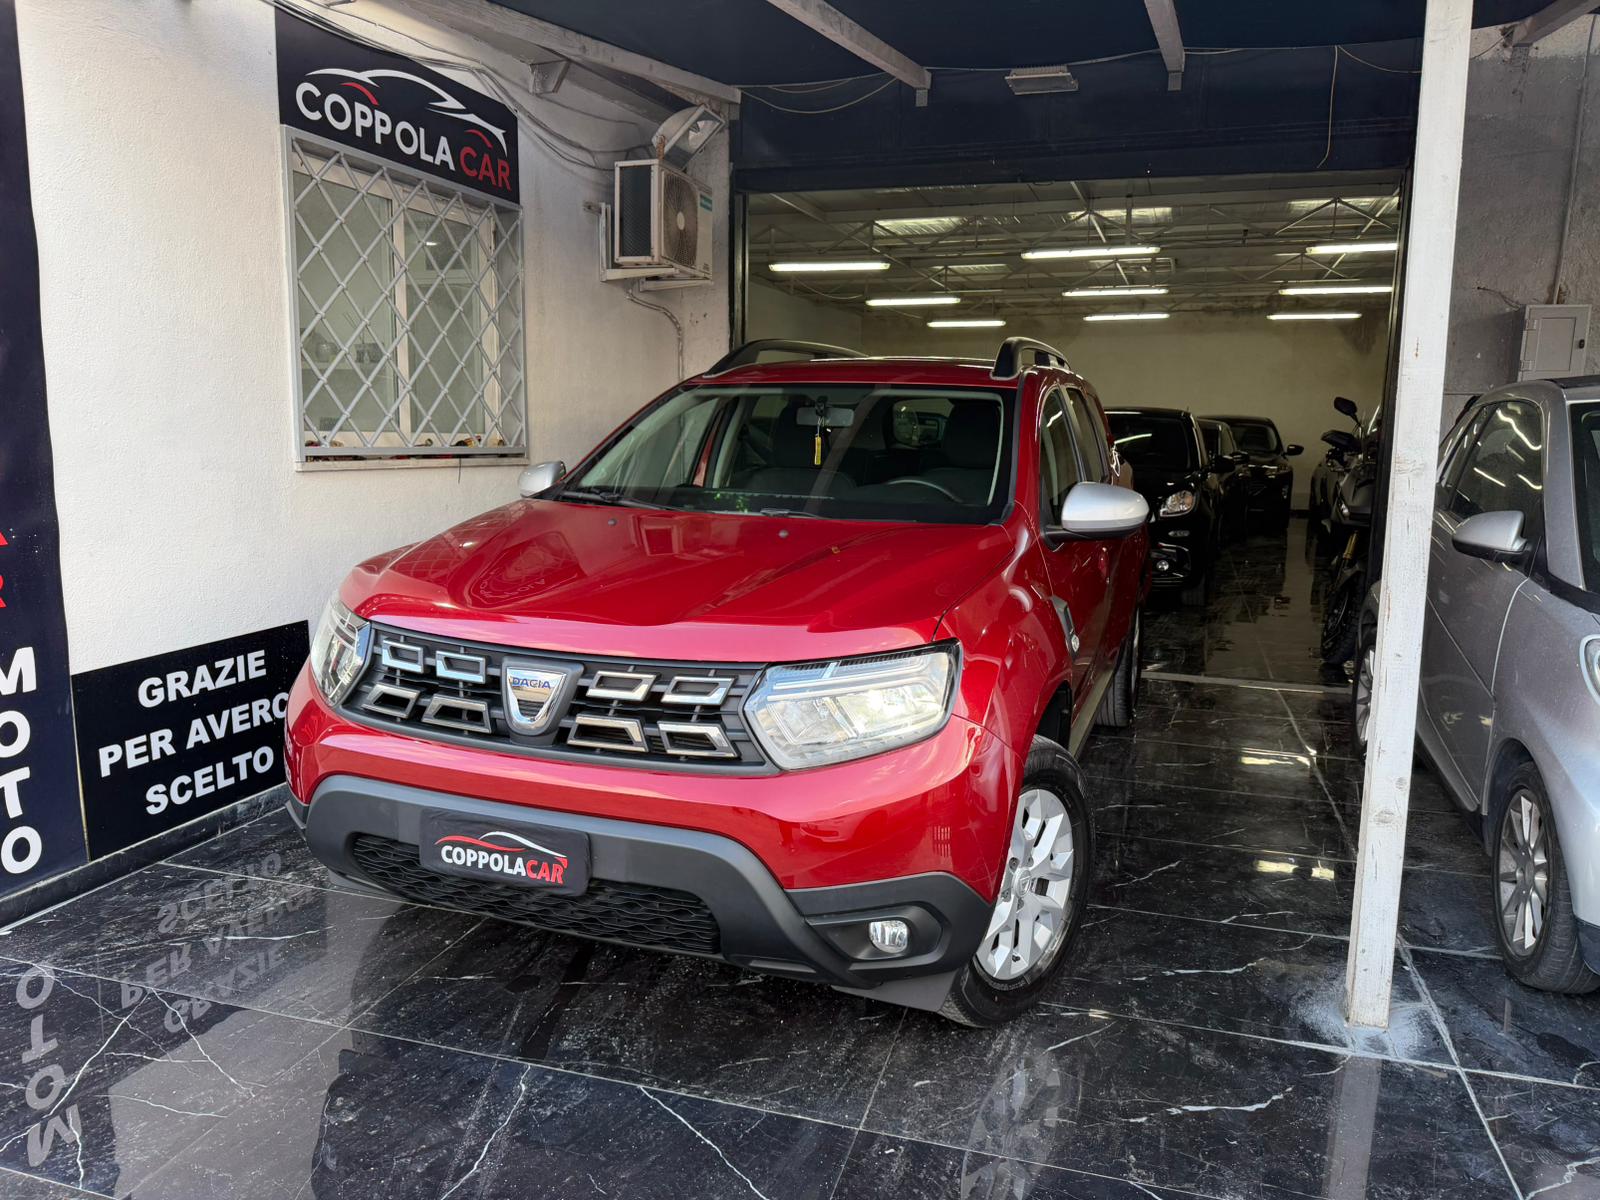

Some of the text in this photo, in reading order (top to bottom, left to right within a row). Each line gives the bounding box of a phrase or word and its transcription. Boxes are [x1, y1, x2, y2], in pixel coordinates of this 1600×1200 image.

[137, 650, 267, 709] GRAZIE
[512, 677, 551, 689] DACIA
[98, 692, 289, 778] PER AVERC
[145, 746, 274, 816] SCELTO
